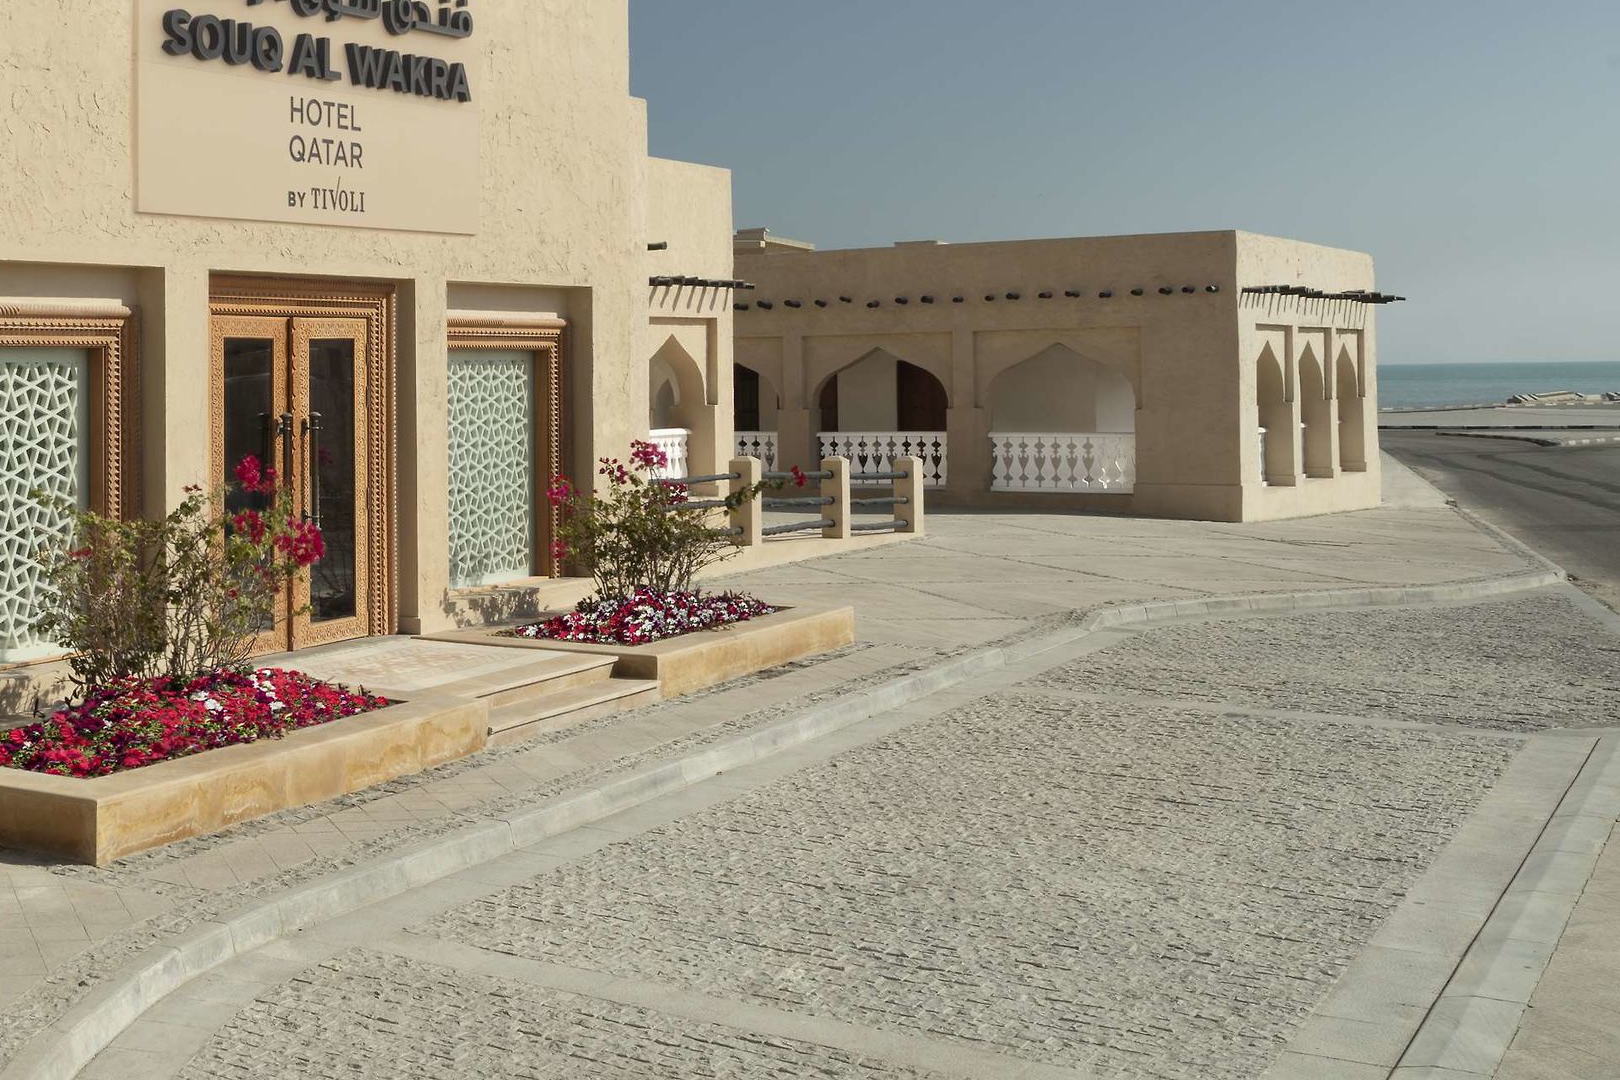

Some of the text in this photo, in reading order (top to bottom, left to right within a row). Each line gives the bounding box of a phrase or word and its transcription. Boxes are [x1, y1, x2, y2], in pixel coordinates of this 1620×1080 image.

[161, 8, 472, 103] SOUQ AL WAKRA
[290, 96, 362, 133] HOTEL
[288, 134, 363, 169] QATAR
[287, 175, 365, 213] BY TIVOLI
